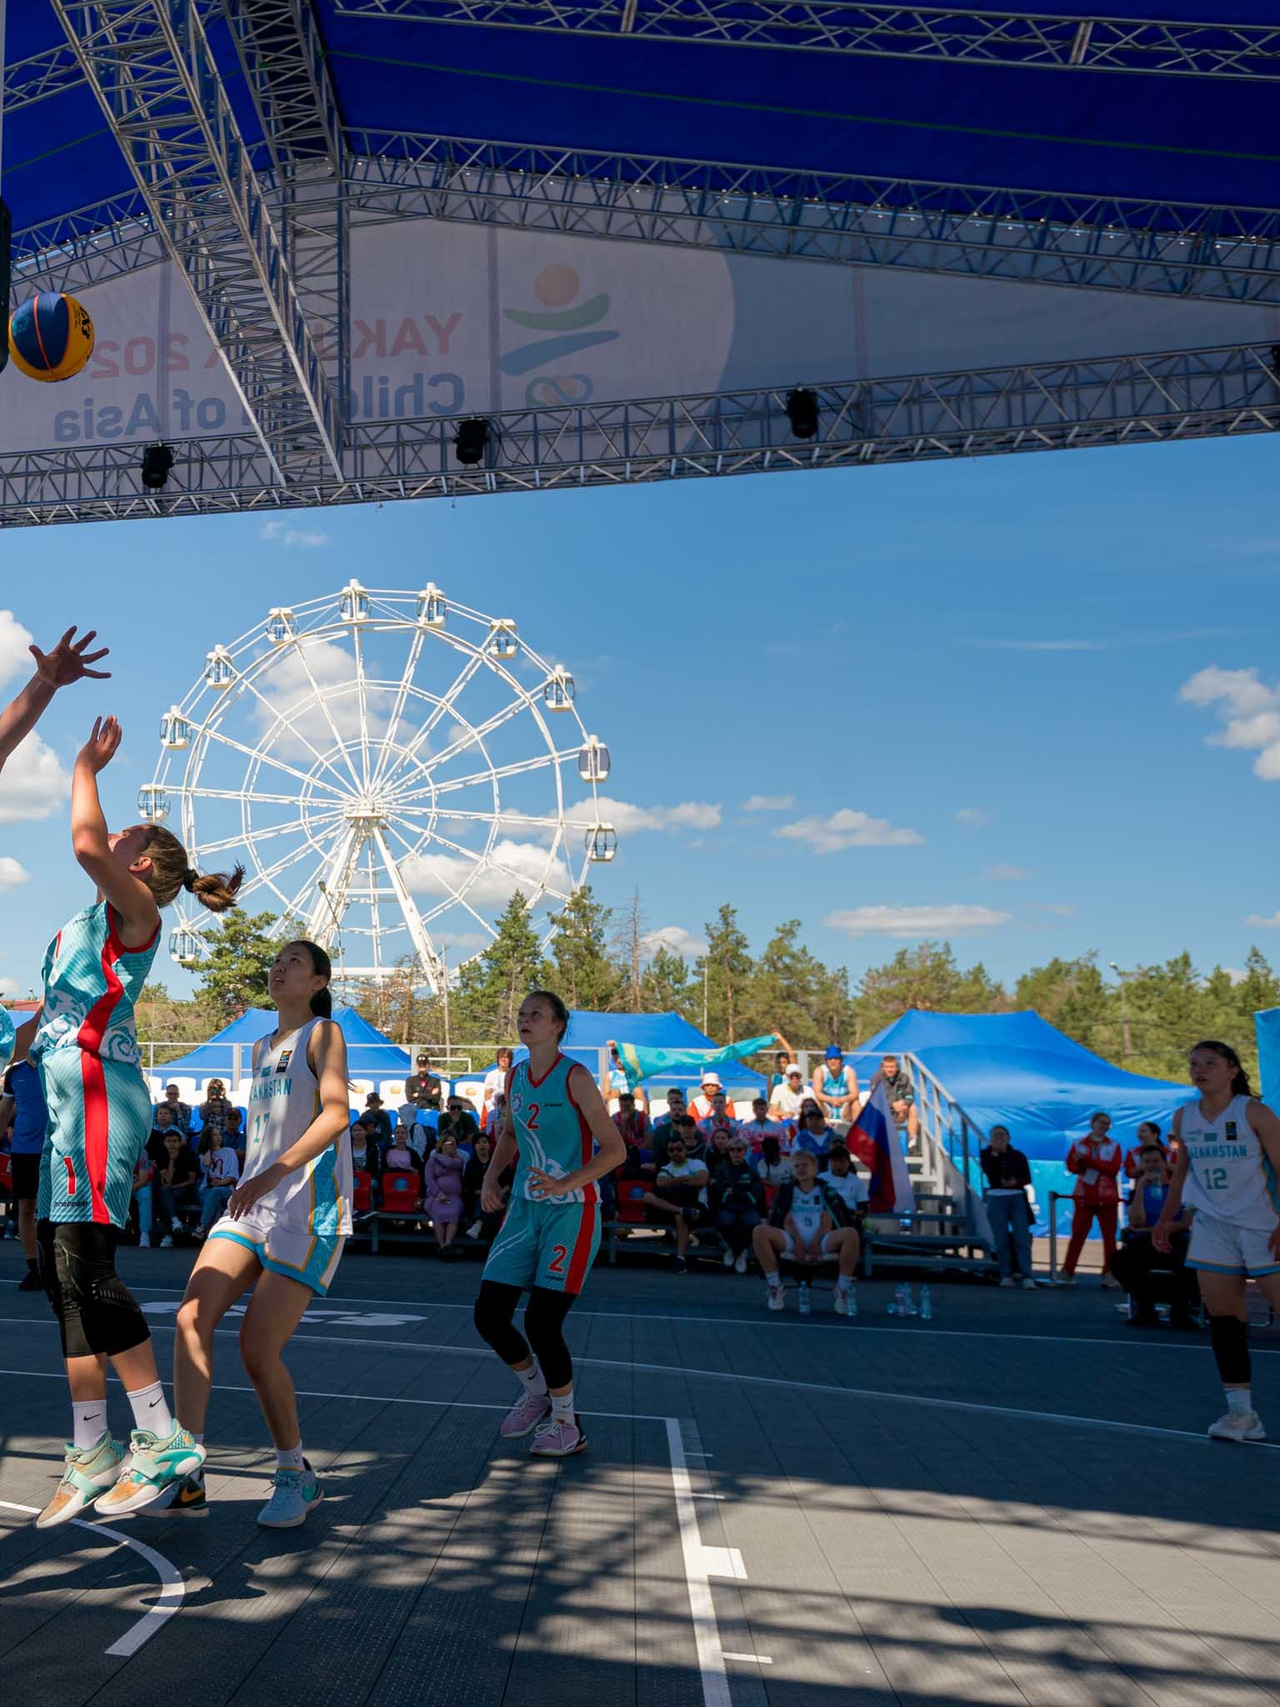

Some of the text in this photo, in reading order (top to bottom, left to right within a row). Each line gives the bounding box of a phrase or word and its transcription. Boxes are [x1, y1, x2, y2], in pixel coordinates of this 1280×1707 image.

[253, 1111, 271, 1143] 17
[527, 1102, 540, 1130] 2
[63, 1155, 77, 1196] 1
[1204, 1167, 1228, 1190] 12
[549, 1244, 568, 1274] 2
